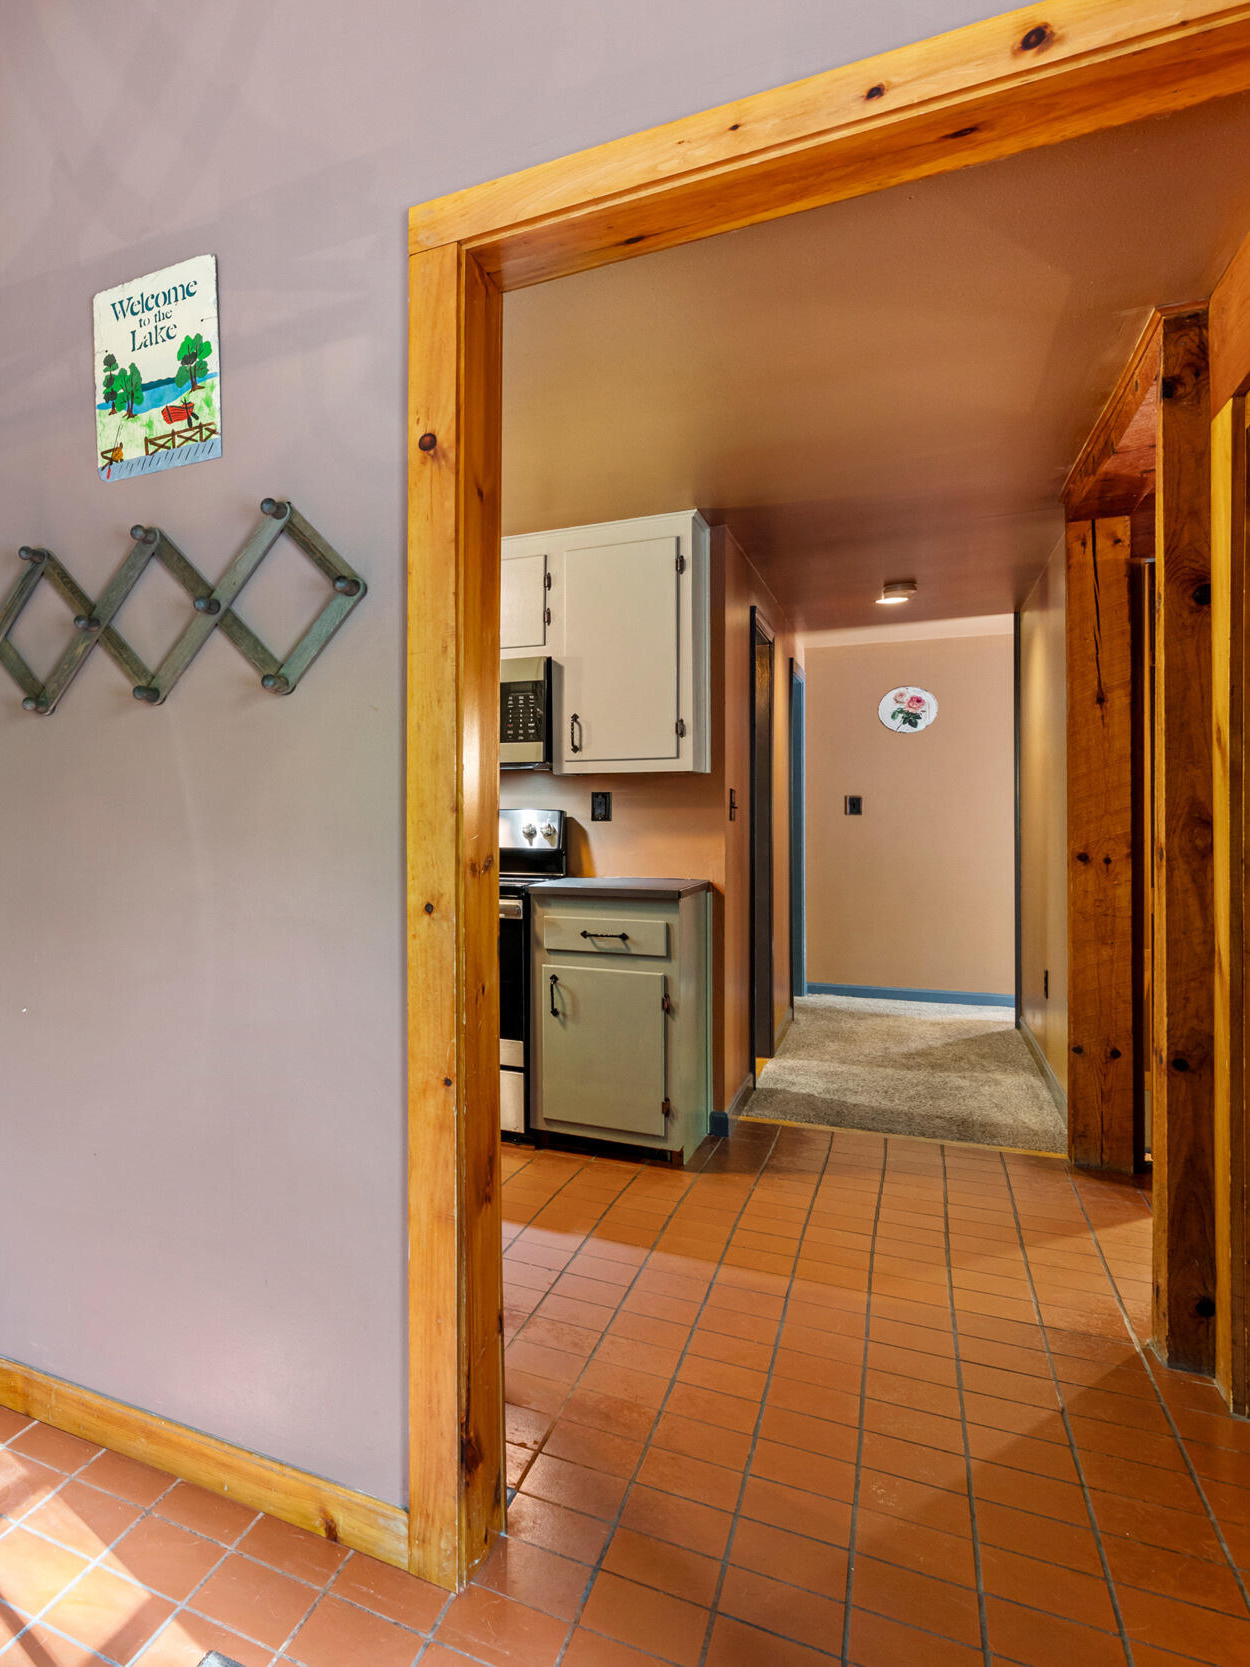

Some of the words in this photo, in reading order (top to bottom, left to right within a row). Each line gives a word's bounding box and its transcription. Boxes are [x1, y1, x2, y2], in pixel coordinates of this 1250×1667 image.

[110, 280, 198, 321] Welcome
[139, 317, 151, 328] to
[154, 309, 173, 323] the
[130, 323, 178, 352] Lake
